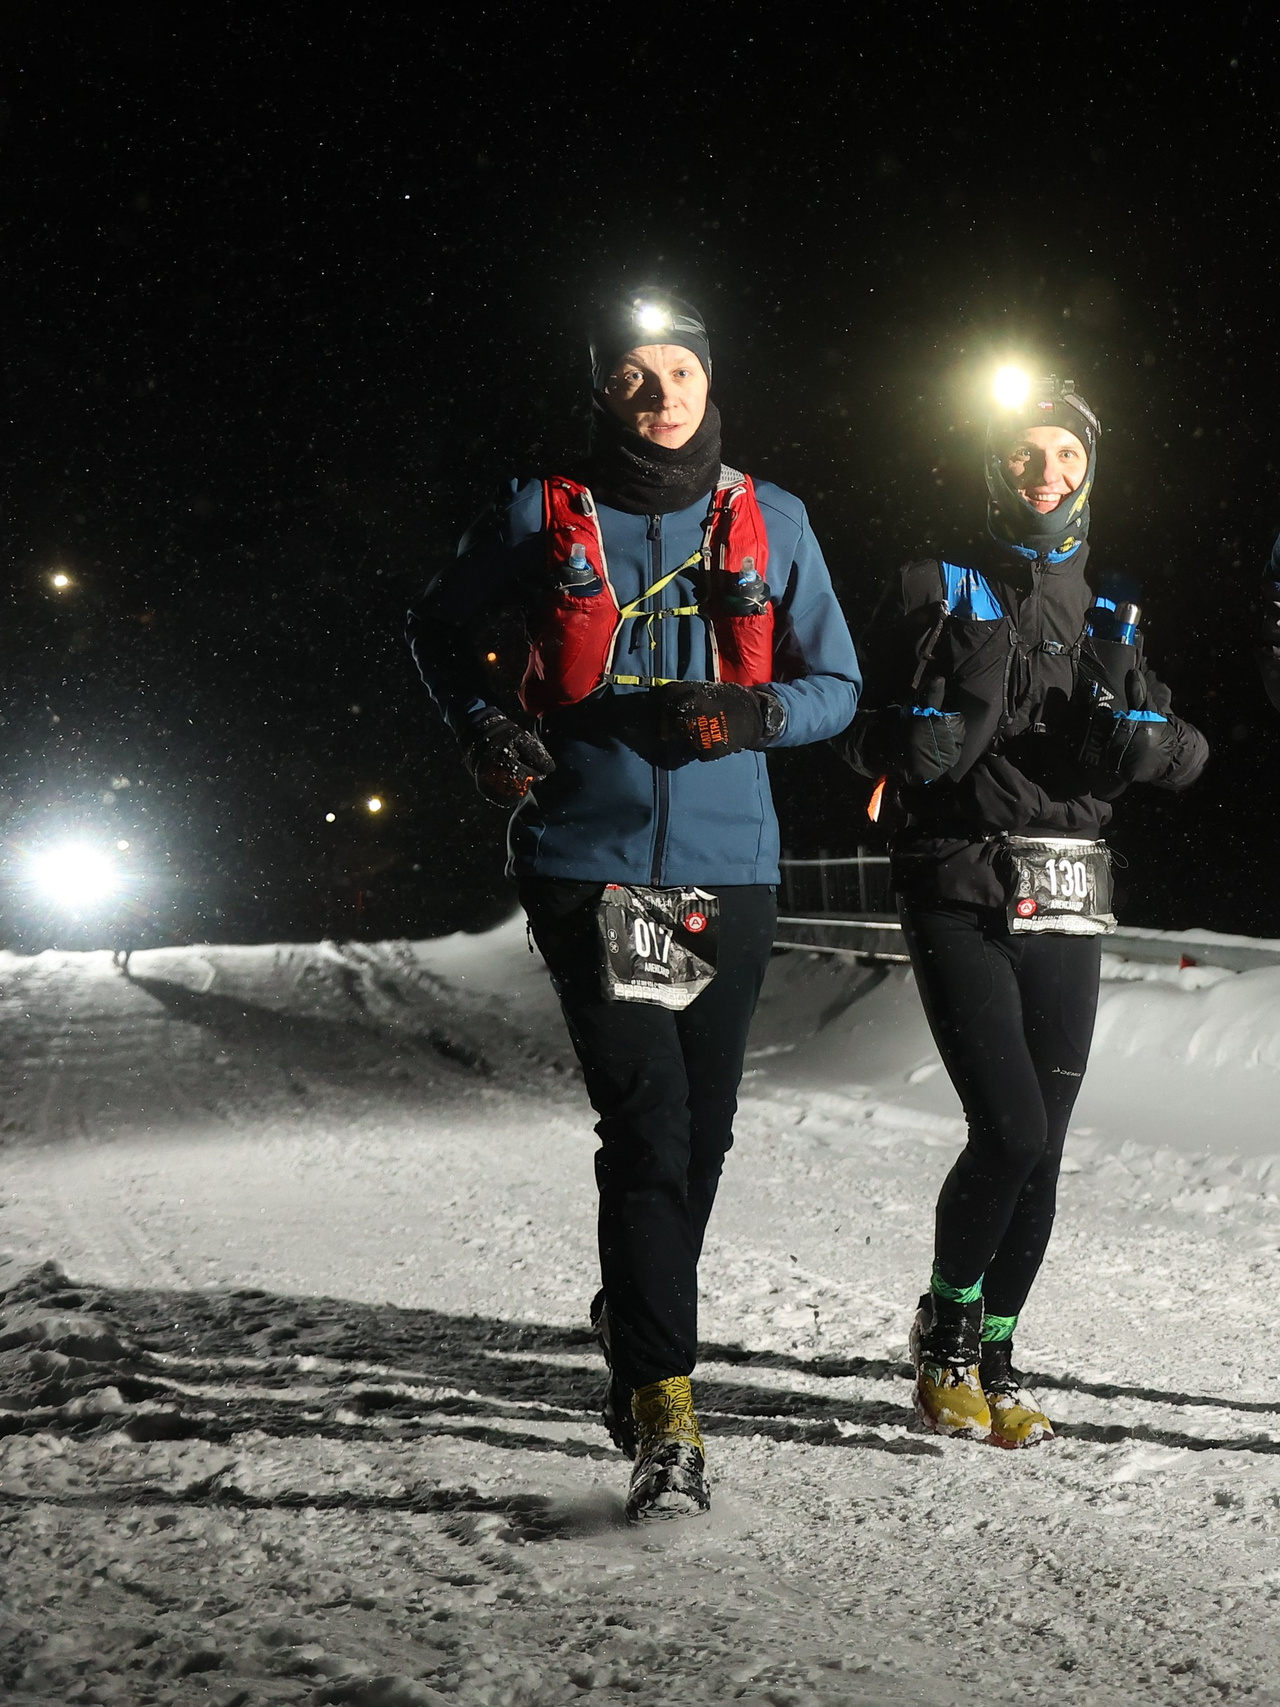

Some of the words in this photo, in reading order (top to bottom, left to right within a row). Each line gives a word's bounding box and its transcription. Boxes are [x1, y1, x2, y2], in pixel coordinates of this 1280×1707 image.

[697, 715, 708, 731] FOX
[709, 717, 722, 742] ULTRA
[701, 732, 712, 749] MAD
[1045, 859, 1088, 898] 130
